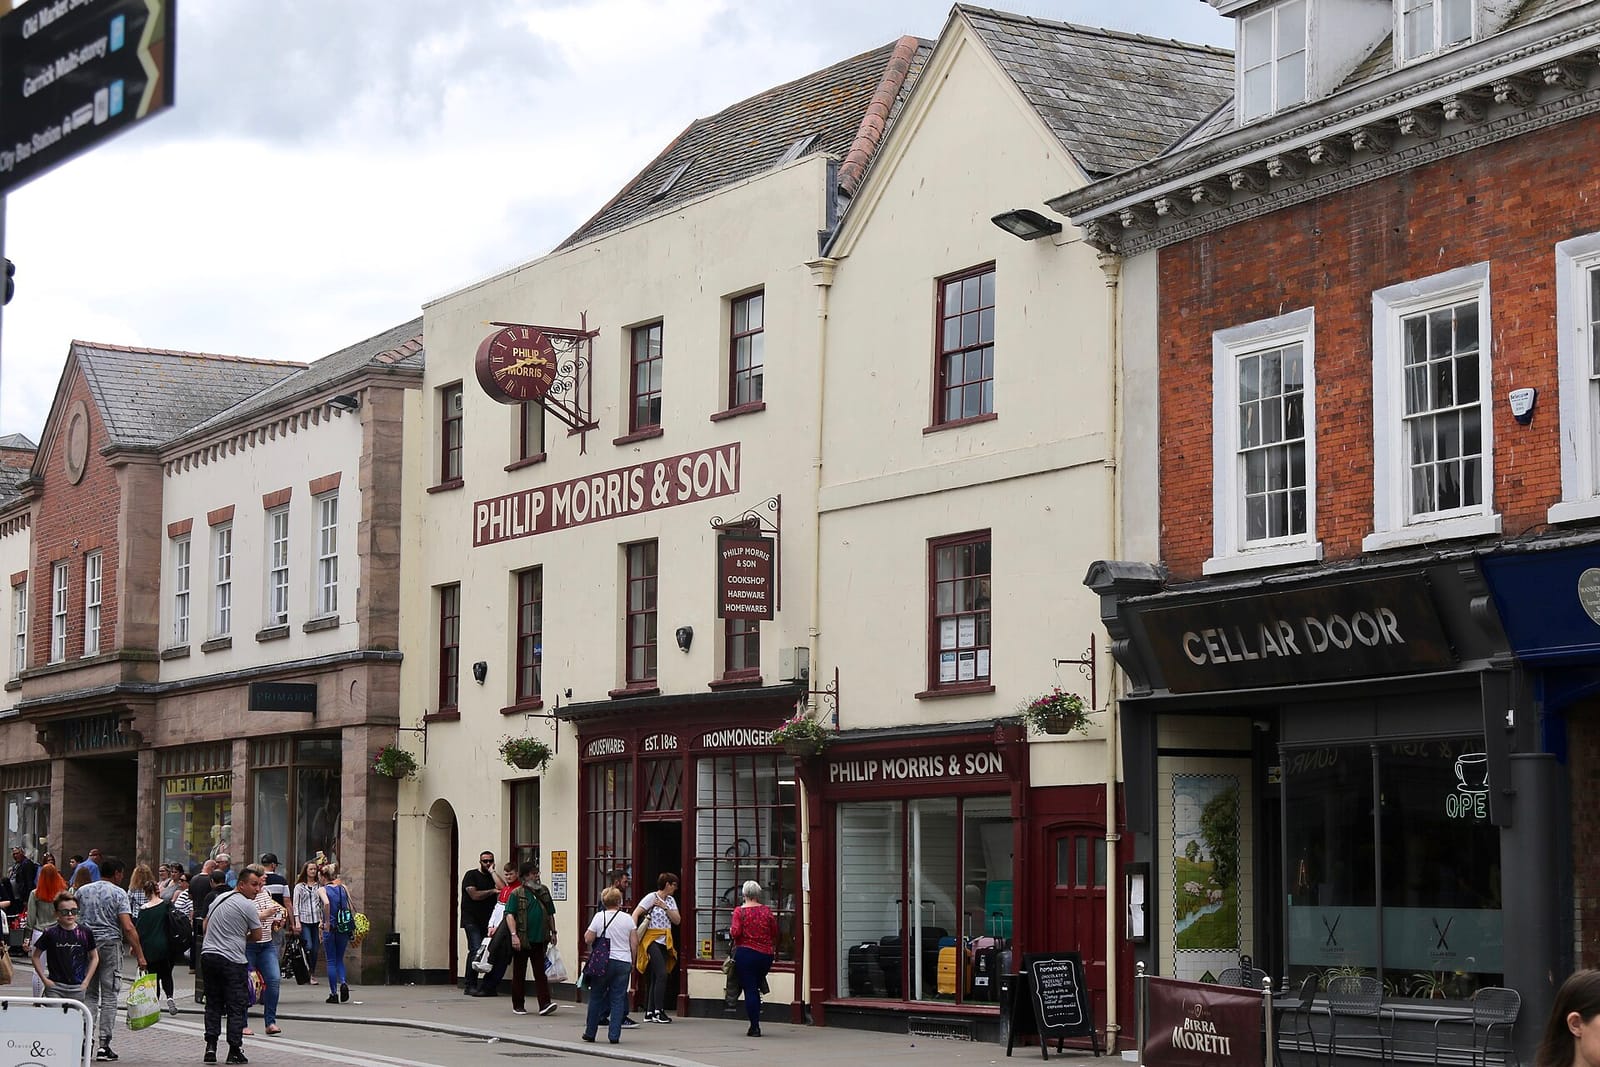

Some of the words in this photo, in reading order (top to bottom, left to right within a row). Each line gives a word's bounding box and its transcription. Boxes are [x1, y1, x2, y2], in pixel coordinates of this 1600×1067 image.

[22, 13, 38, 39] Old
[39, 0, 69, 29] Market
[23, 64, 55, 98] Garrick
[15, 142, 32, 163] Bus
[31, 126, 62, 154] Station
[512, 347, 539, 358] PHILIP
[507, 365, 542, 378] MORRIS
[476, 490, 545, 543] PHILIP
[552, 467, 644, 527] MORRIS
[651, 462, 670, 507] &
[677, 446, 736, 501] SON
[723, 547, 744, 559] PHILIP
[745, 547, 770, 561] MORRIS
[742, 560, 756, 568] SON
[727, 575, 765, 585] COOKSHOP
[727, 590, 765, 599] HARDWARE
[725, 603, 767, 613] HOMEWARES
[1182, 619, 1301, 665] CELLAR
[1303, 607, 1405, 654] DOOR
[588, 738, 625, 756] HOUSEWARES
[644, 736, 660, 751] EST.
[661, 733, 678, 750] 1845
[703, 728, 777, 748] IRONMONGER
[829, 760, 878, 783] PHILIP
[881, 755, 944, 780] MORRIS
[948, 754, 961, 776] &
[965, 751, 1003, 775] SON
[1446, 793, 1487, 818] OPE
[1184, 1017, 1217, 1034] BIRRA
[1172, 1026, 1231, 1056] MORETTI
